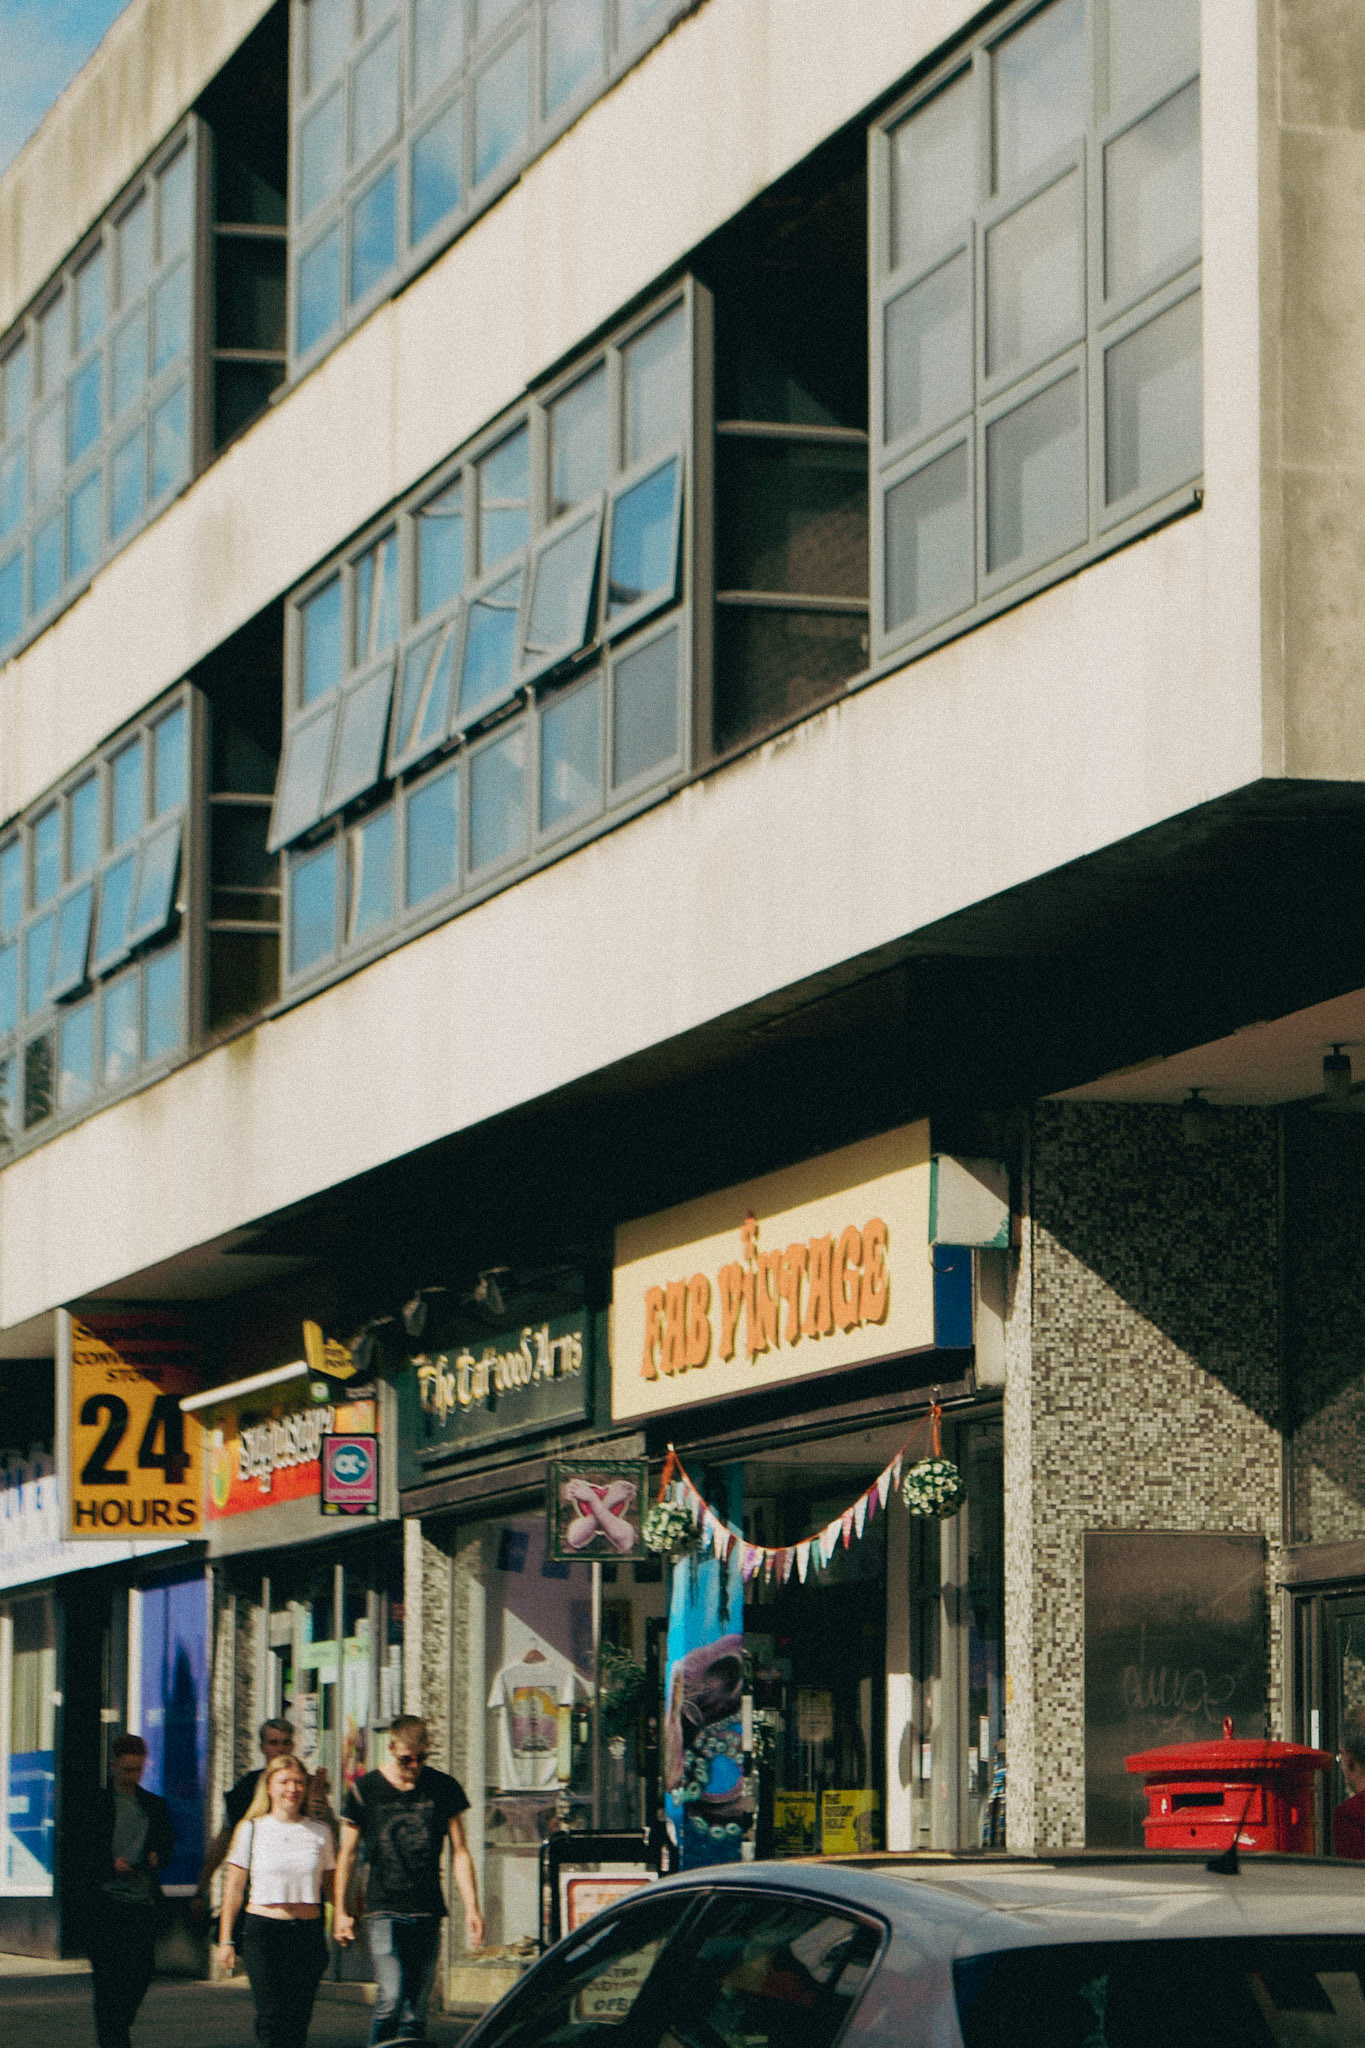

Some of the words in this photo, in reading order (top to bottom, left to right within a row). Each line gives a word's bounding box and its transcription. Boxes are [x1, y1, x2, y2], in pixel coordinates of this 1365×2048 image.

[641, 1272, 712, 1382] FAB
[717, 1210, 891, 1366] VINTAGE
[411, 1353, 456, 1427] The
[80, 1393, 191, 1485] 24
[75, 1499, 198, 1527] HOURS
[593, 1997, 635, 2013] OPE
